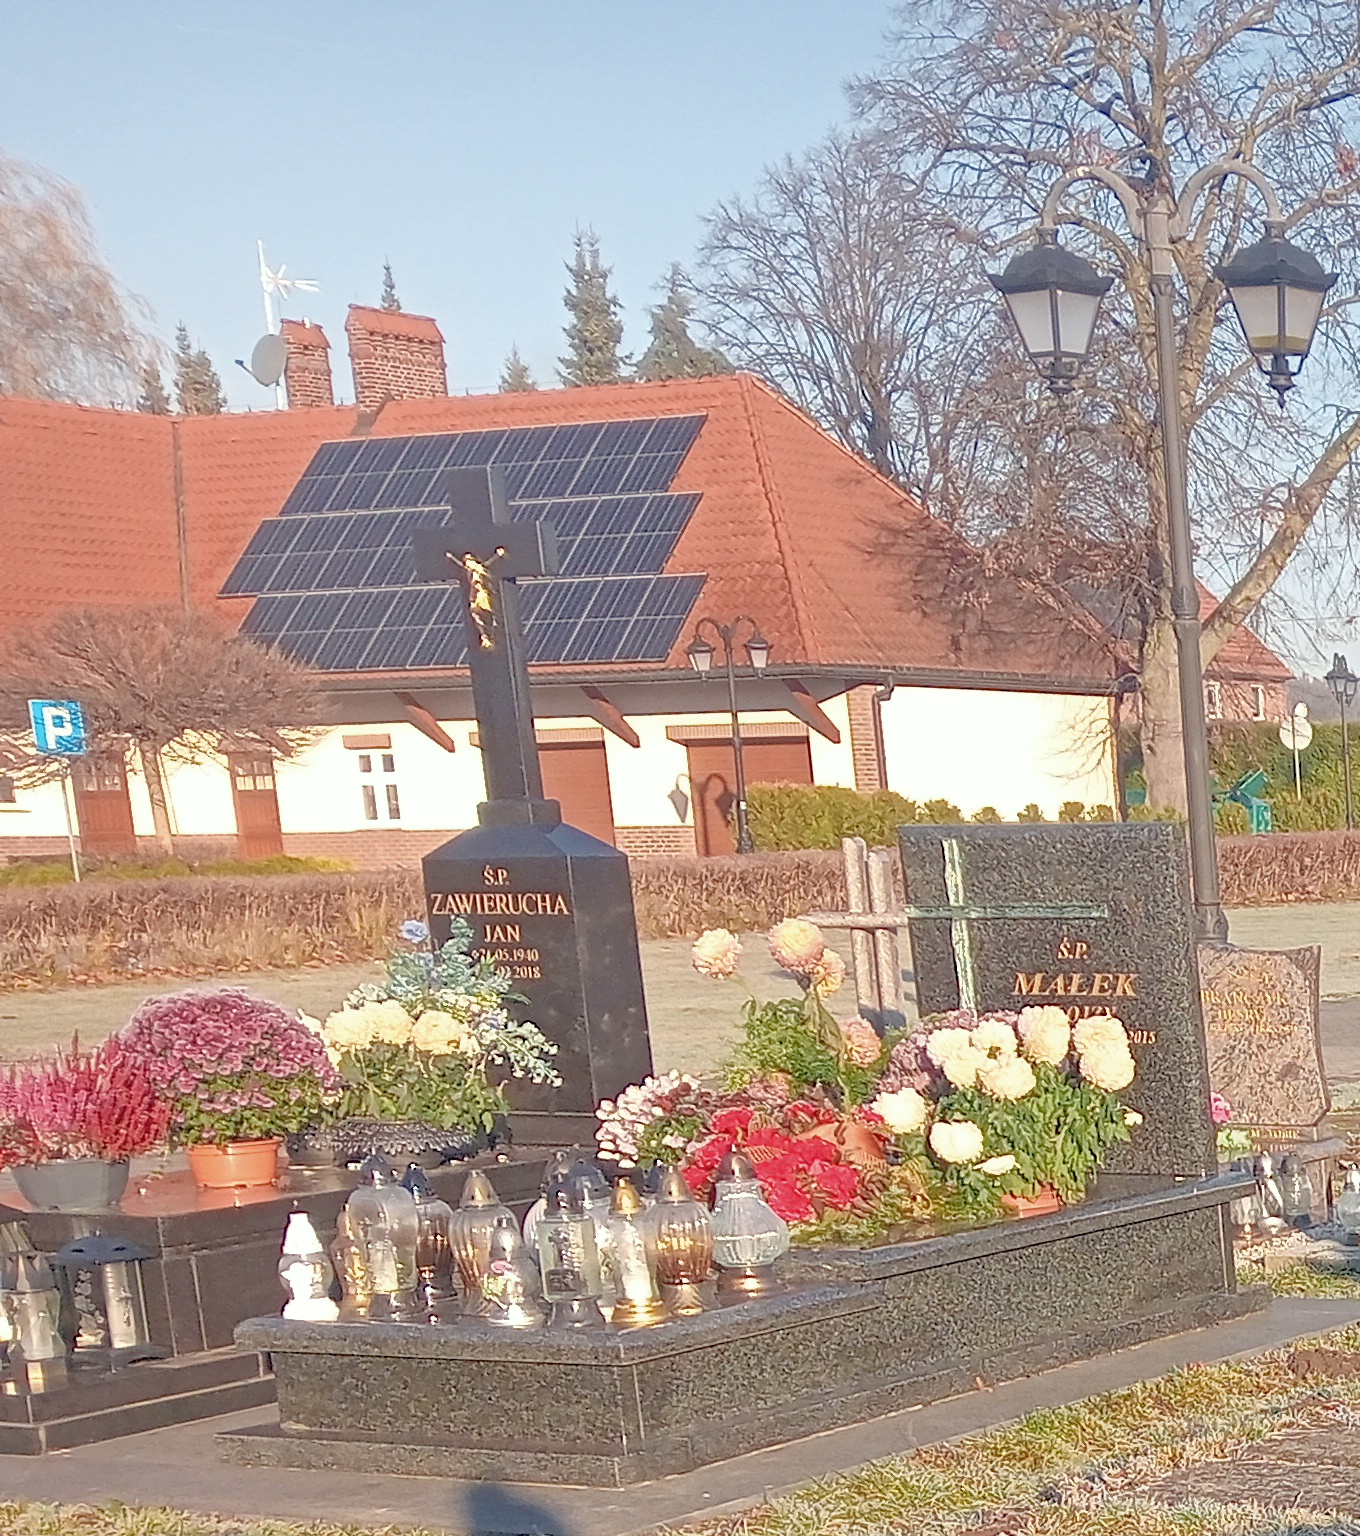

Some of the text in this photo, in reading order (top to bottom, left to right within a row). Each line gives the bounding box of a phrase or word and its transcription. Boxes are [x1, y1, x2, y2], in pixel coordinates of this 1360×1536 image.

[42, 706, 73, 750] P
[483, 864, 511, 886] Ś.P.
[430, 892, 571, 916] ZAWIERUCHA
[483, 923, 522, 944] JAN
[1057, 936, 1089, 960] Ś.P.
[1011, 972, 1140, 998] MAŁEK
